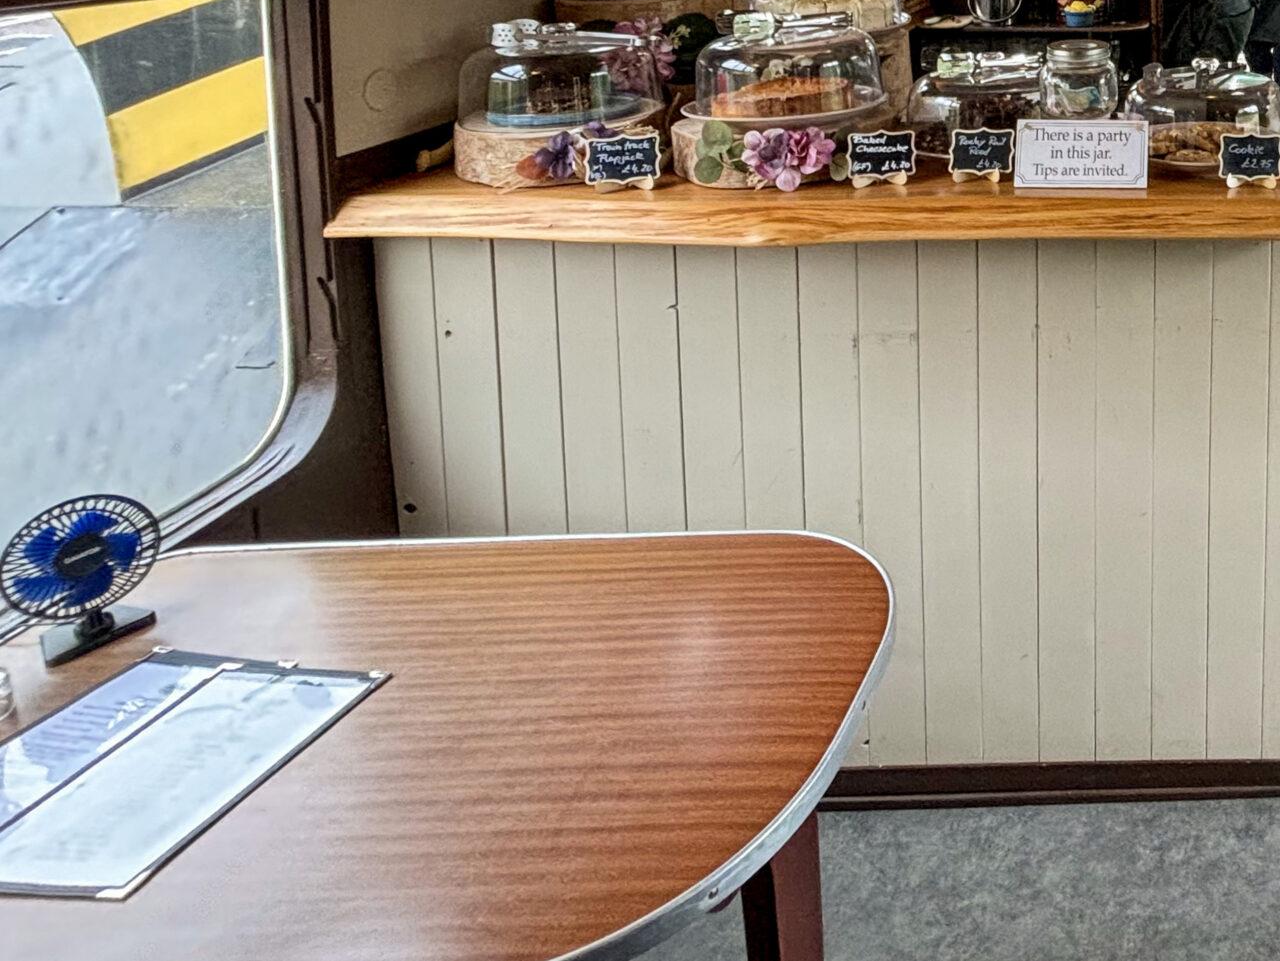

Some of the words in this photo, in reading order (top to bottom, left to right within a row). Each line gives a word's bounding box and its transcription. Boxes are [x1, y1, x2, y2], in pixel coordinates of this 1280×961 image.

[853, 135, 887, 144] Baked
[958, 135, 986, 148] Rocky
[1034, 128, 1070, 141] There
[1073, 129, 1083, 141] is
[1086, 132, 1094, 141] a
[1097, 130, 1132, 146] party
[856, 143, 909, 153] Cheesecake
[1228, 143, 1265, 155] Cookie
[1050, 146, 1063, 159] in
[1067, 146, 1090, 159] this
[1092, 147, 1112, 163] jar.
[881, 160, 911, 171] £4.20
[1033, 163, 1058, 180] Tips
[1061, 167, 1080, 176] are
[1083, 163, 1128, 176] invited.
